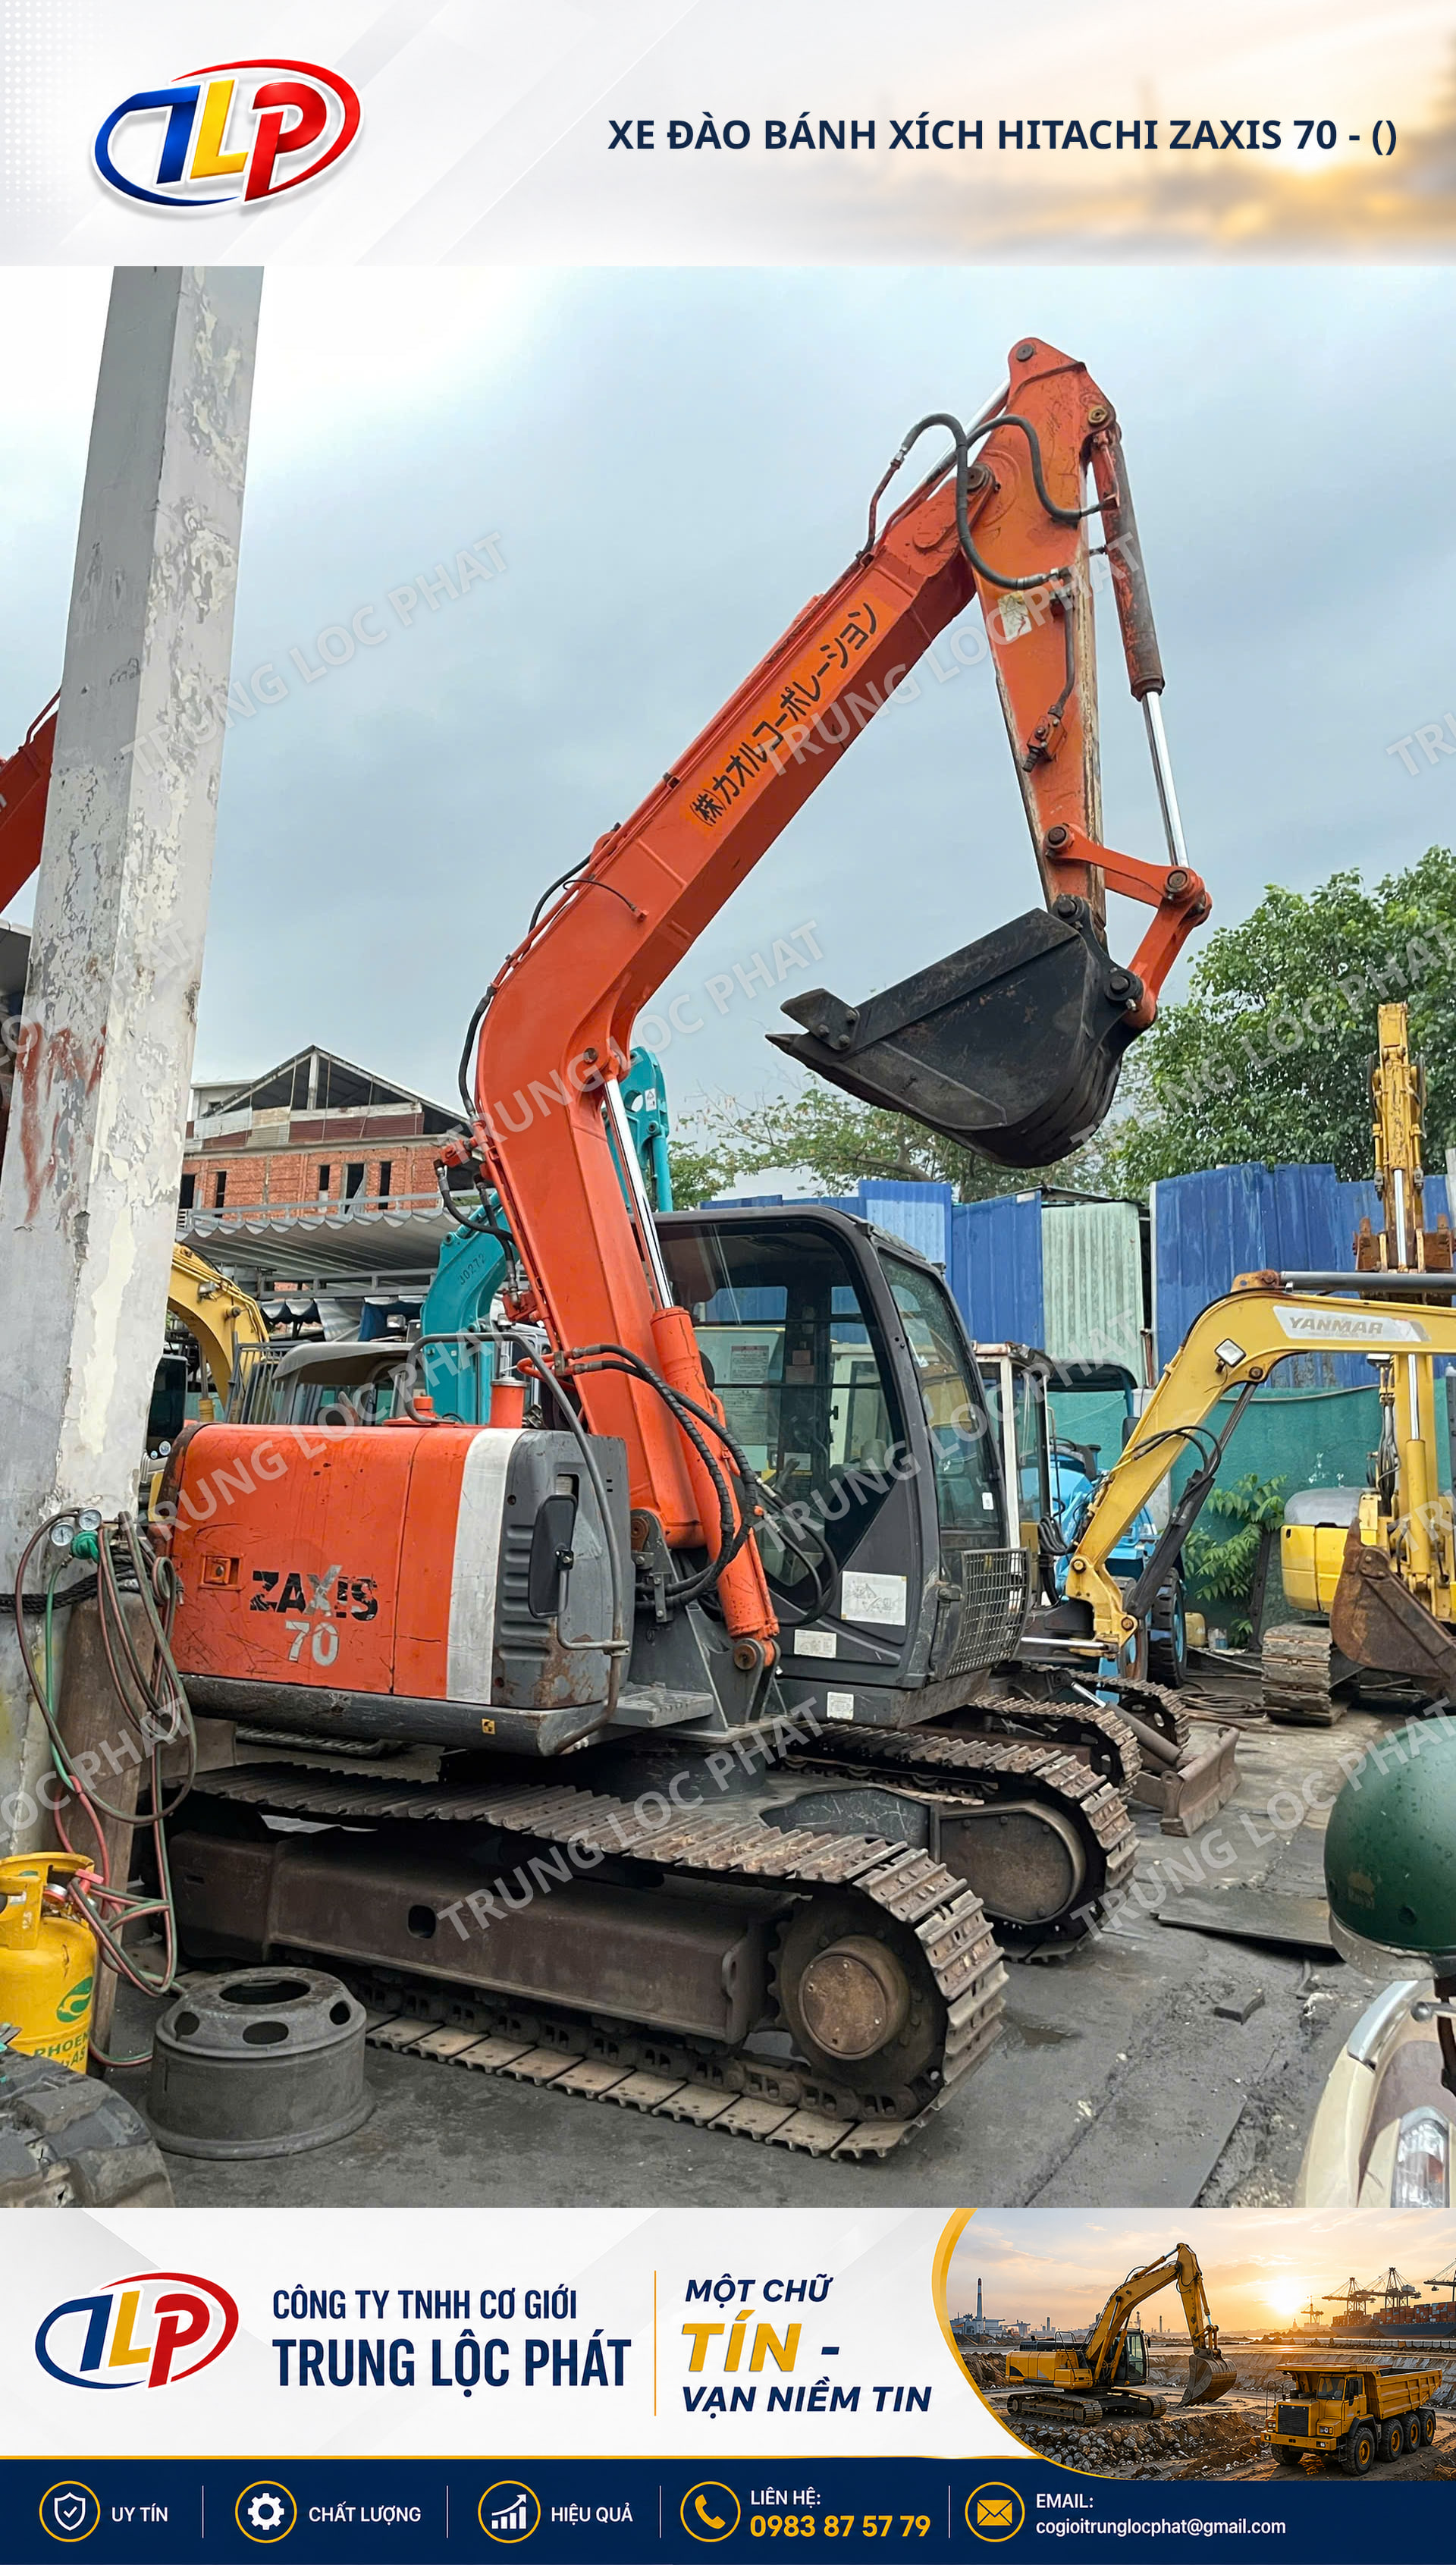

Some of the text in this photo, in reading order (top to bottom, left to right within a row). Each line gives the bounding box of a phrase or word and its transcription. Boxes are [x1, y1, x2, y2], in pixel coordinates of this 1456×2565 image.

[1289, 1317, 1383, 1335] YANMAR
[249, 1564, 378, 1622] ZAXIS
[285, 1620, 340, 1666] 70
